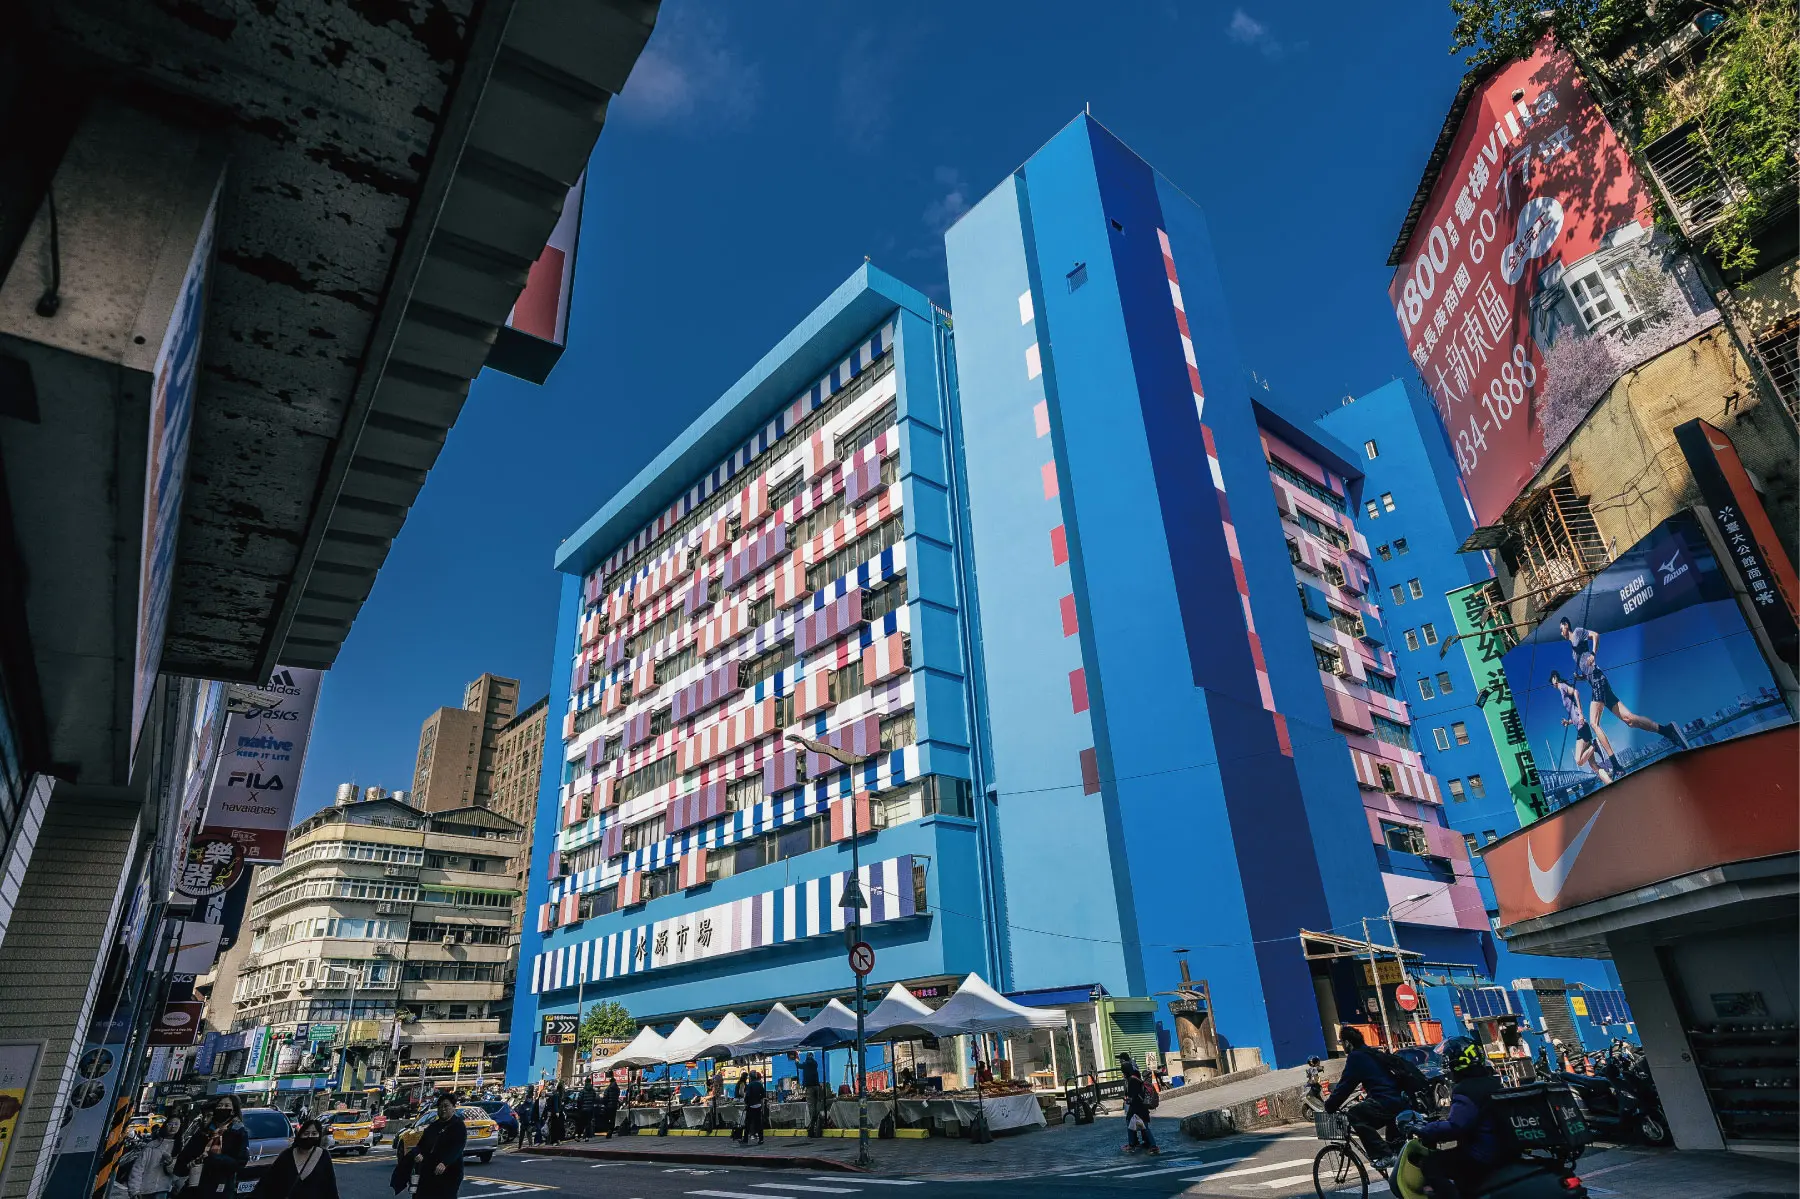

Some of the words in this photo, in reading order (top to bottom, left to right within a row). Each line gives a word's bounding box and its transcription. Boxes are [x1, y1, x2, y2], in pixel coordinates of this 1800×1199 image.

[1397, 226, 1449, 340] 1800
[1620, 575, 1646, 602] REACH
[1623, 586, 1654, 615] BEYOND
[257, 684, 301, 696] adidas
[237, 736, 294, 751] native
[236, 750, 259, 758] KEEP
[228, 772, 284, 791] FILA
[635, 918, 713, 962] 水源市場
[546, 1021, 556, 1034] P
[595, 1048, 609, 1057] 30
[1510, 1116, 1541, 1129] Uber
[1515, 1129, 1546, 1141] Eats
